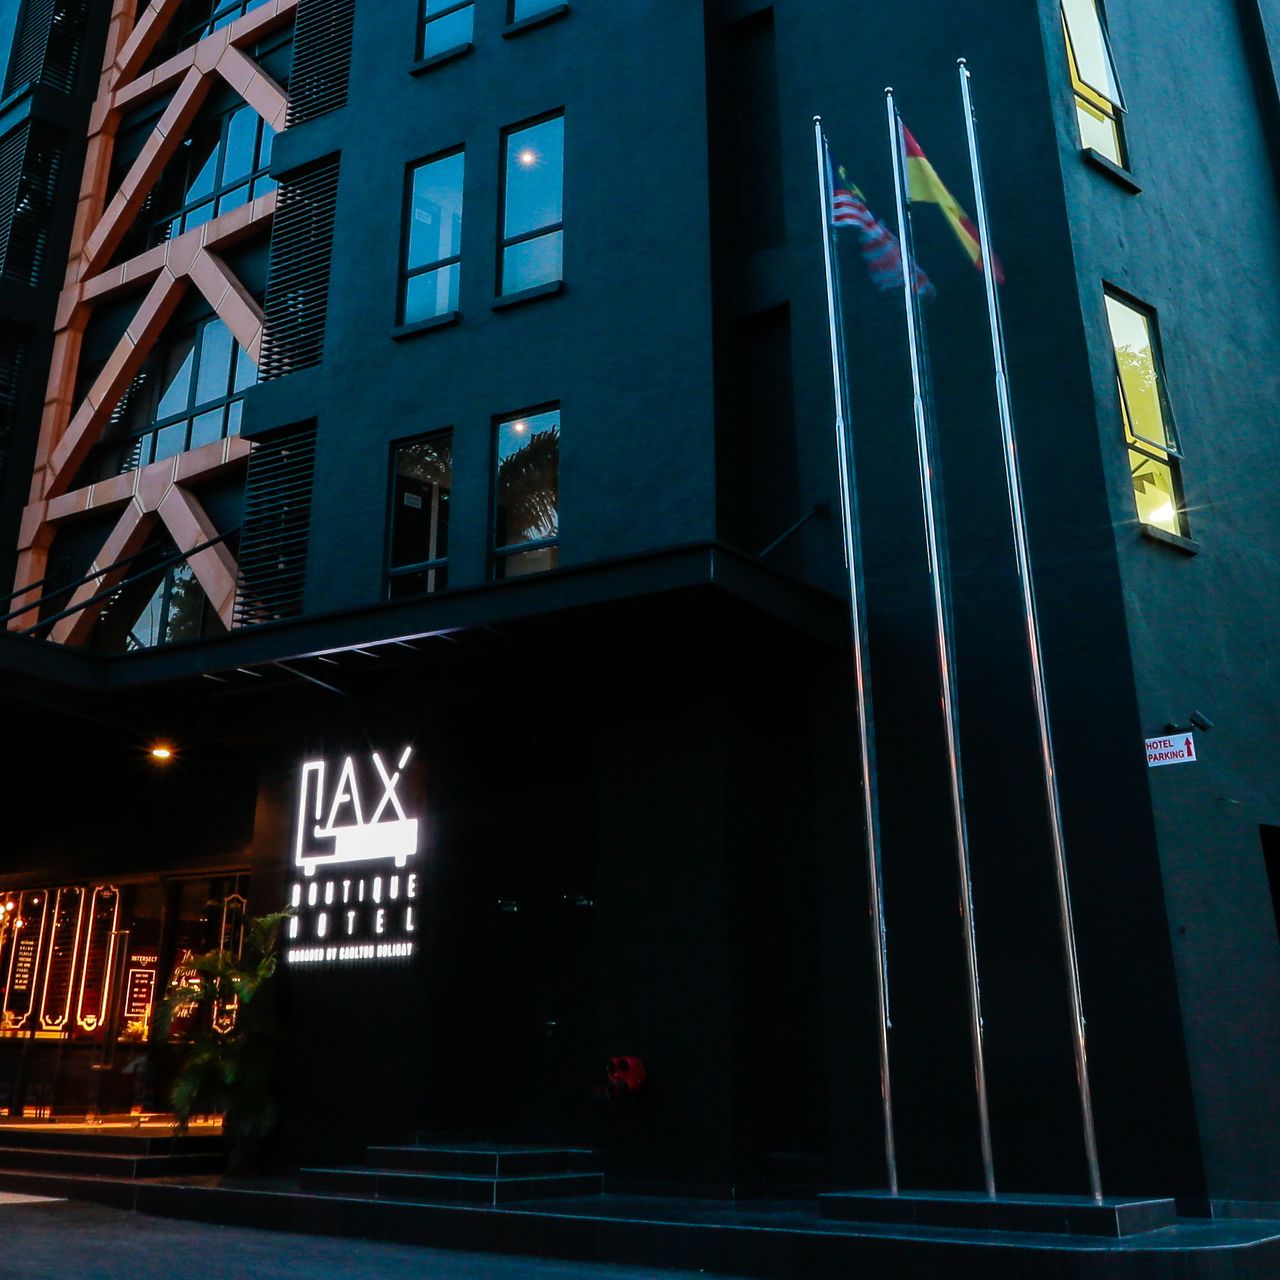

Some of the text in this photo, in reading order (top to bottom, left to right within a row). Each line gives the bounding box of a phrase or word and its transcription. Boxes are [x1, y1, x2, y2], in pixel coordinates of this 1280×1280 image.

[1146, 740, 1173, 750] HOTEL
[1148, 750, 1185, 762] PARKING
[295, 746, 412, 867] LAX
[291, 874, 417, 907] BOUTIQUE
[289, 907, 414, 938] HOTEL
[131, 955, 158, 963] INTERSECT
